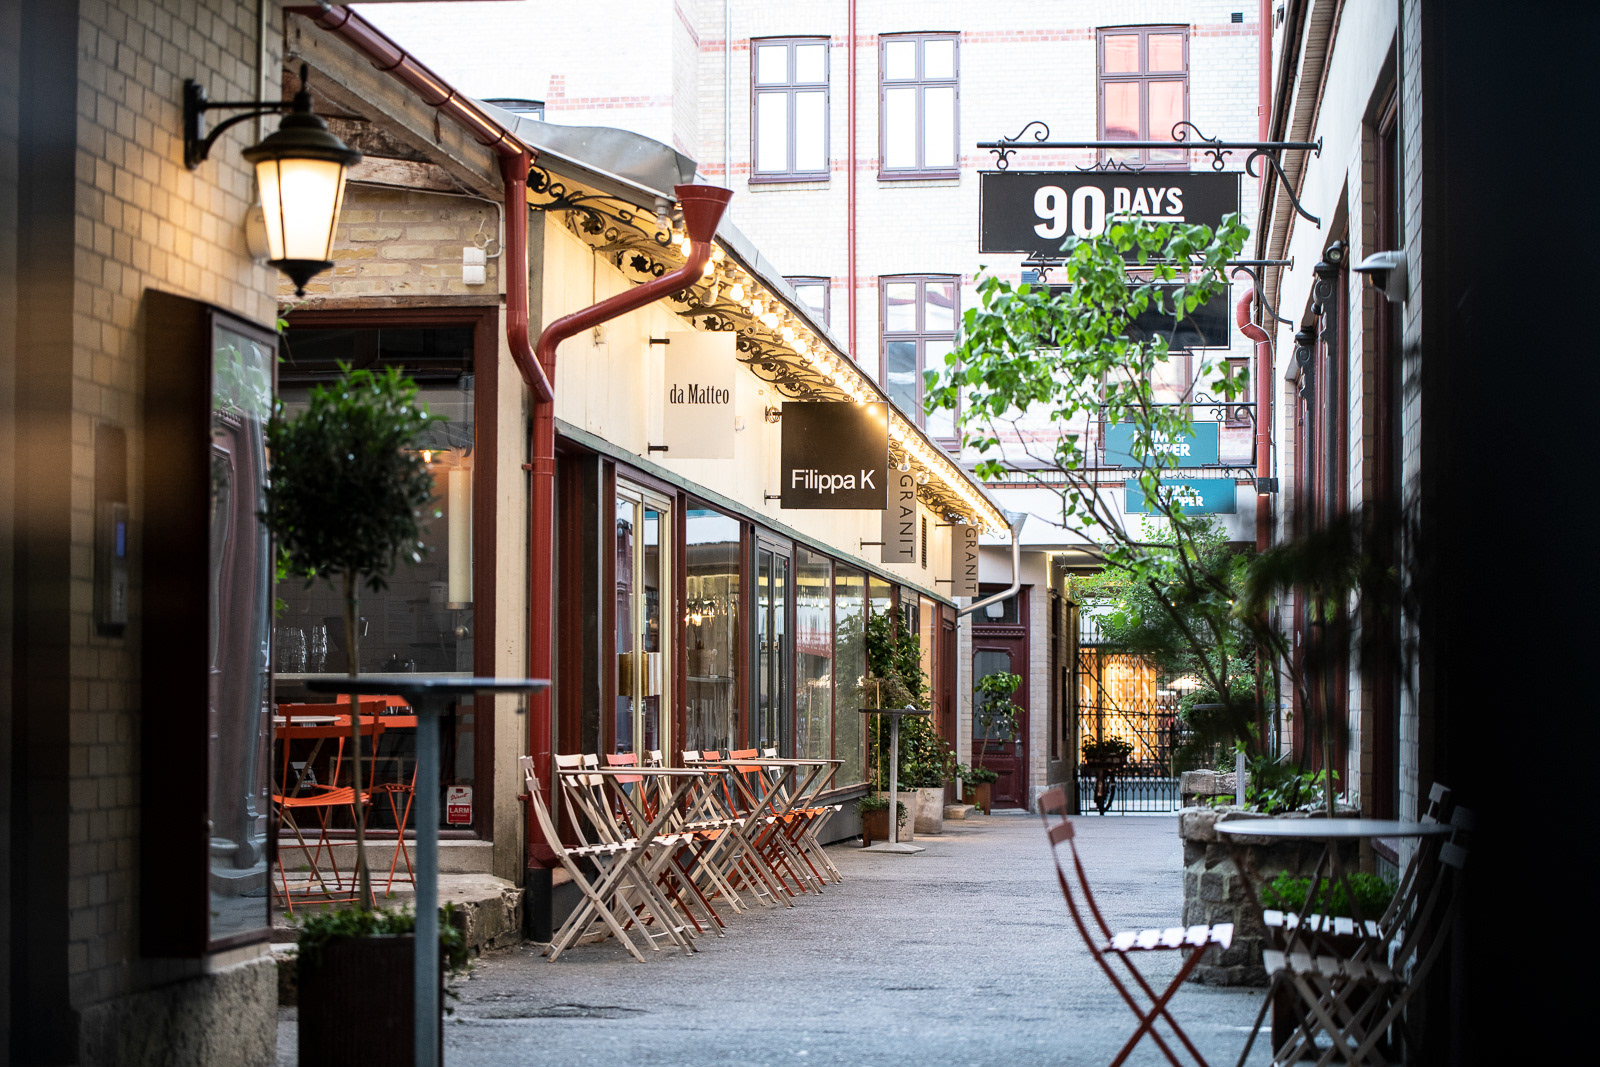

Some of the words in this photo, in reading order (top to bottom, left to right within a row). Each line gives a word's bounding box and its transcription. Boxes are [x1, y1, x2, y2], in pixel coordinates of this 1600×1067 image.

[1033, 185, 1106, 239] 90
[1113, 187, 1184, 215] DAYS
[669, 383, 685, 405] da
[688, 383, 730, 405] Matteo
[791, 469, 856, 494] Filippa
[860, 469, 876, 490] K
[899, 474, 914, 558] GRANIT
[965, 527, 977, 593] GRANIT
